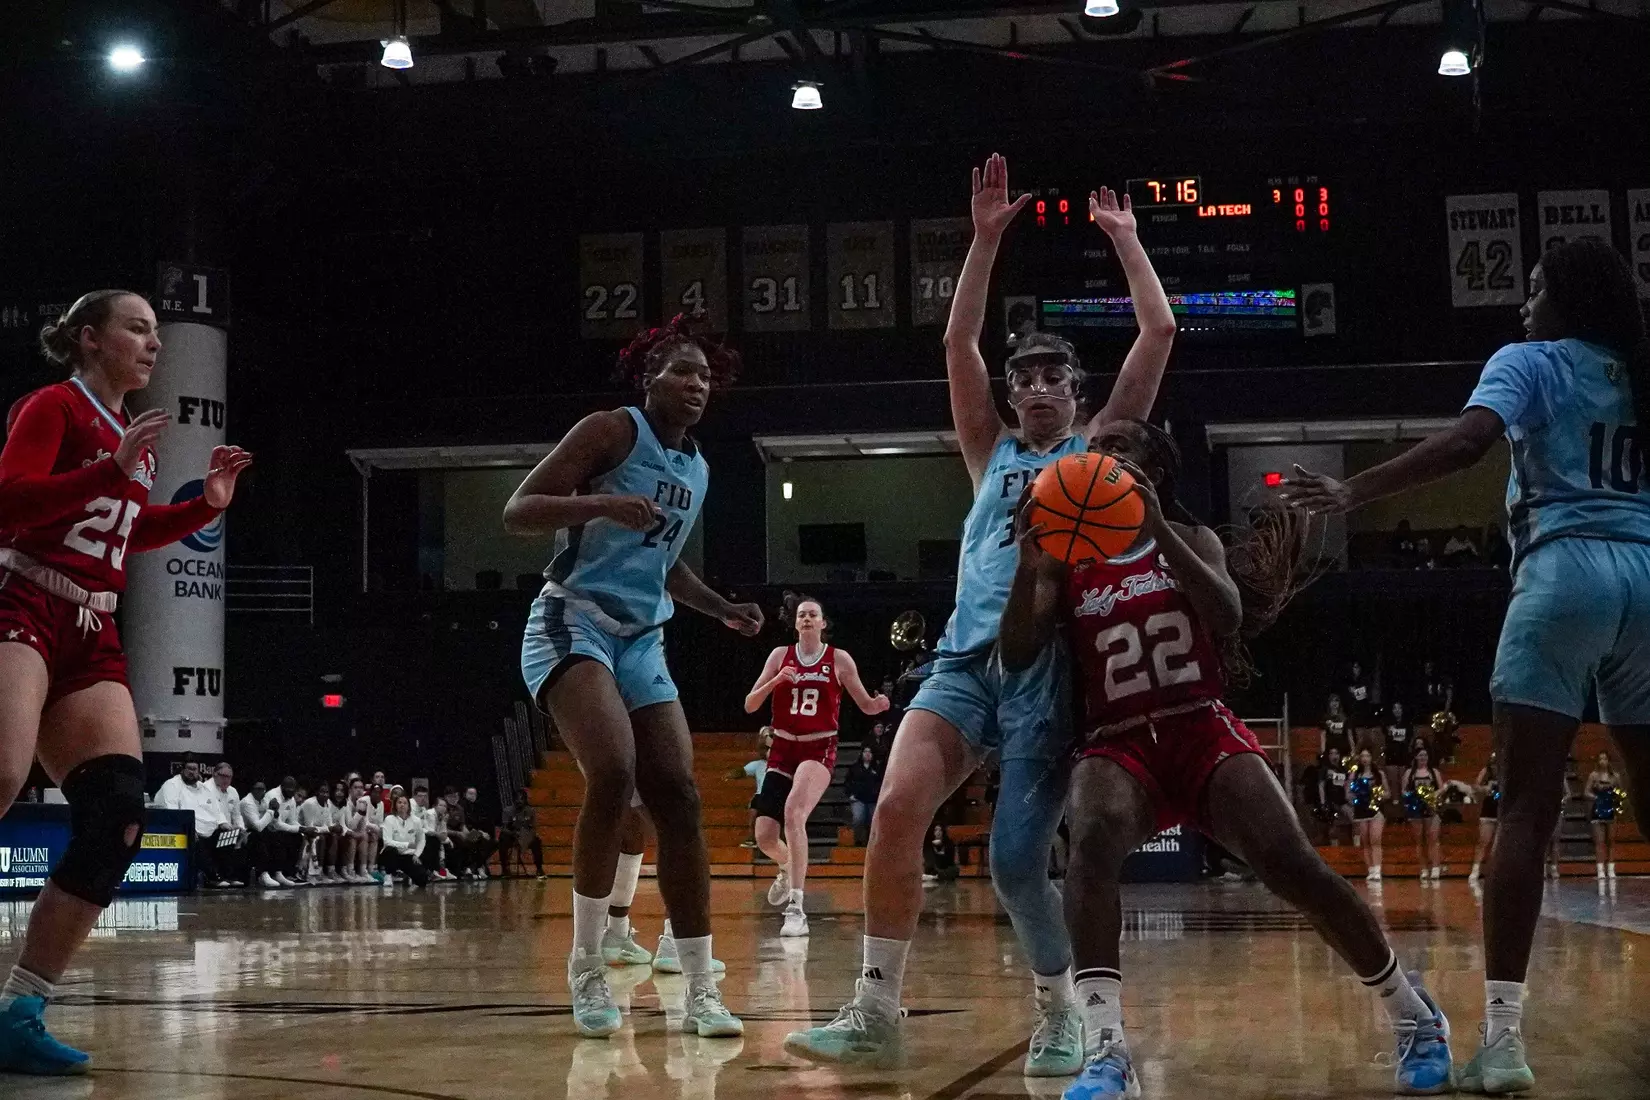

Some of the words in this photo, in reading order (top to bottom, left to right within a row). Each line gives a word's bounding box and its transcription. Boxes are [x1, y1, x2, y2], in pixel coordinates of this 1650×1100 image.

[1147, 179, 1198, 203] 7:16
[1272, 188, 1281, 203] 3
[1294, 188, 1304, 203] 0
[1319, 186, 1328, 201] 3
[1036, 200, 1046, 214] 0
[1059, 199, 1069, 214] 0
[1198, 205, 1217, 217] LA
[1217, 203, 1252, 216] TECH
[1295, 203, 1305, 217] 0
[1319, 202, 1329, 216] 0
[1450, 208, 1516, 231] STEWART
[1543, 204, 1606, 225] BELL
[1456, 240, 1514, 291] 42
[192, 274, 213, 315] 1
[584, 283, 638, 320] 22
[682, 281, 708, 319] 4
[752, 276, 801, 313] 31
[840, 273, 880, 310] 11
[162, 299, 185, 312] N.E.
[178, 396, 225, 429] FIU
[653, 480, 693, 511] FIU
[641, 514, 684, 552] 24
[166, 558, 224, 580] OCEAN
[175, 580, 222, 601] BANK
[1095, 610, 1202, 702] 22
[172, 667, 221, 697] FIU
[790, 688, 820, 717] 18
[11, 847, 49, 863] ALUMNI
[11, 864, 49, 873] ASSOCIATION
